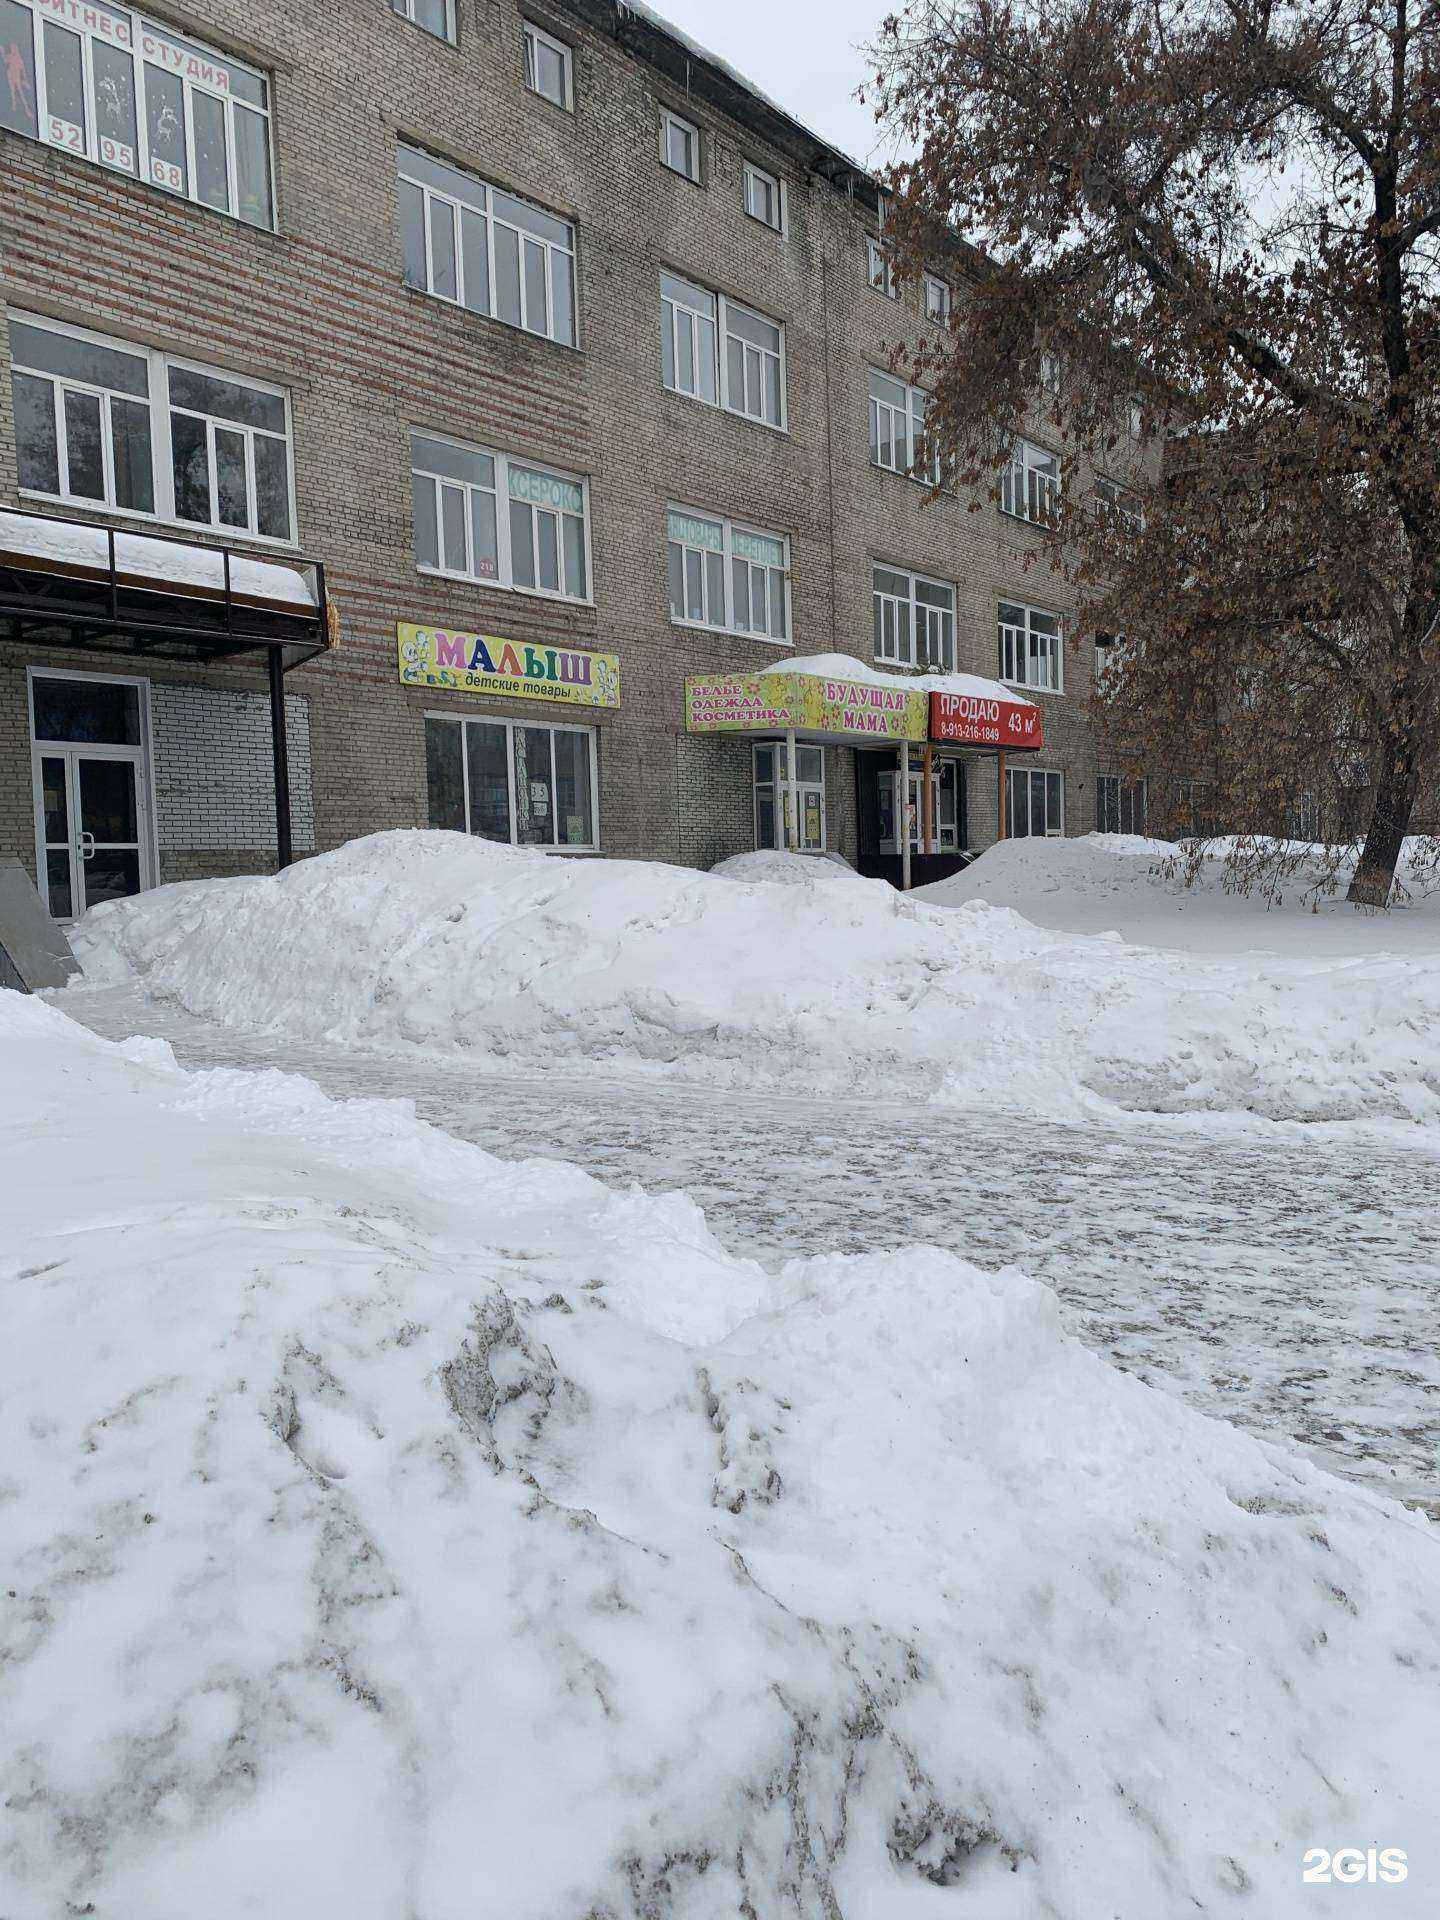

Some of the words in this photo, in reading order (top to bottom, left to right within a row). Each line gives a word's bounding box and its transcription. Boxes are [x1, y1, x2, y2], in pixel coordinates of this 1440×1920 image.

[40, 0, 128, 42] ИТНЕС
[142, 36, 229, 91] СТУДИЯ
[50, 119, 82, 150] 52
[102, 140, 131, 168] 95
[153, 161, 182, 187] 68
[435, 633, 593, 686] МАЛЫШ
[465, 672, 519, 692] детские
[523, 682, 571, 698] товары
[691, 685, 743, 696] БЕЛЬЕ
[826, 682, 906, 711] БУДУЩАЯ
[691, 697, 764, 709] ОДЕЖДА
[692, 709, 791, 721] КОСМЕТИКА
[941, 694, 1000, 723] ПРОДАЮ
[844, 711, 889, 733] МАМА
[941, 721, 1000, 741] 8-913-216-1849
[1008, 713, 1022, 732] 43
